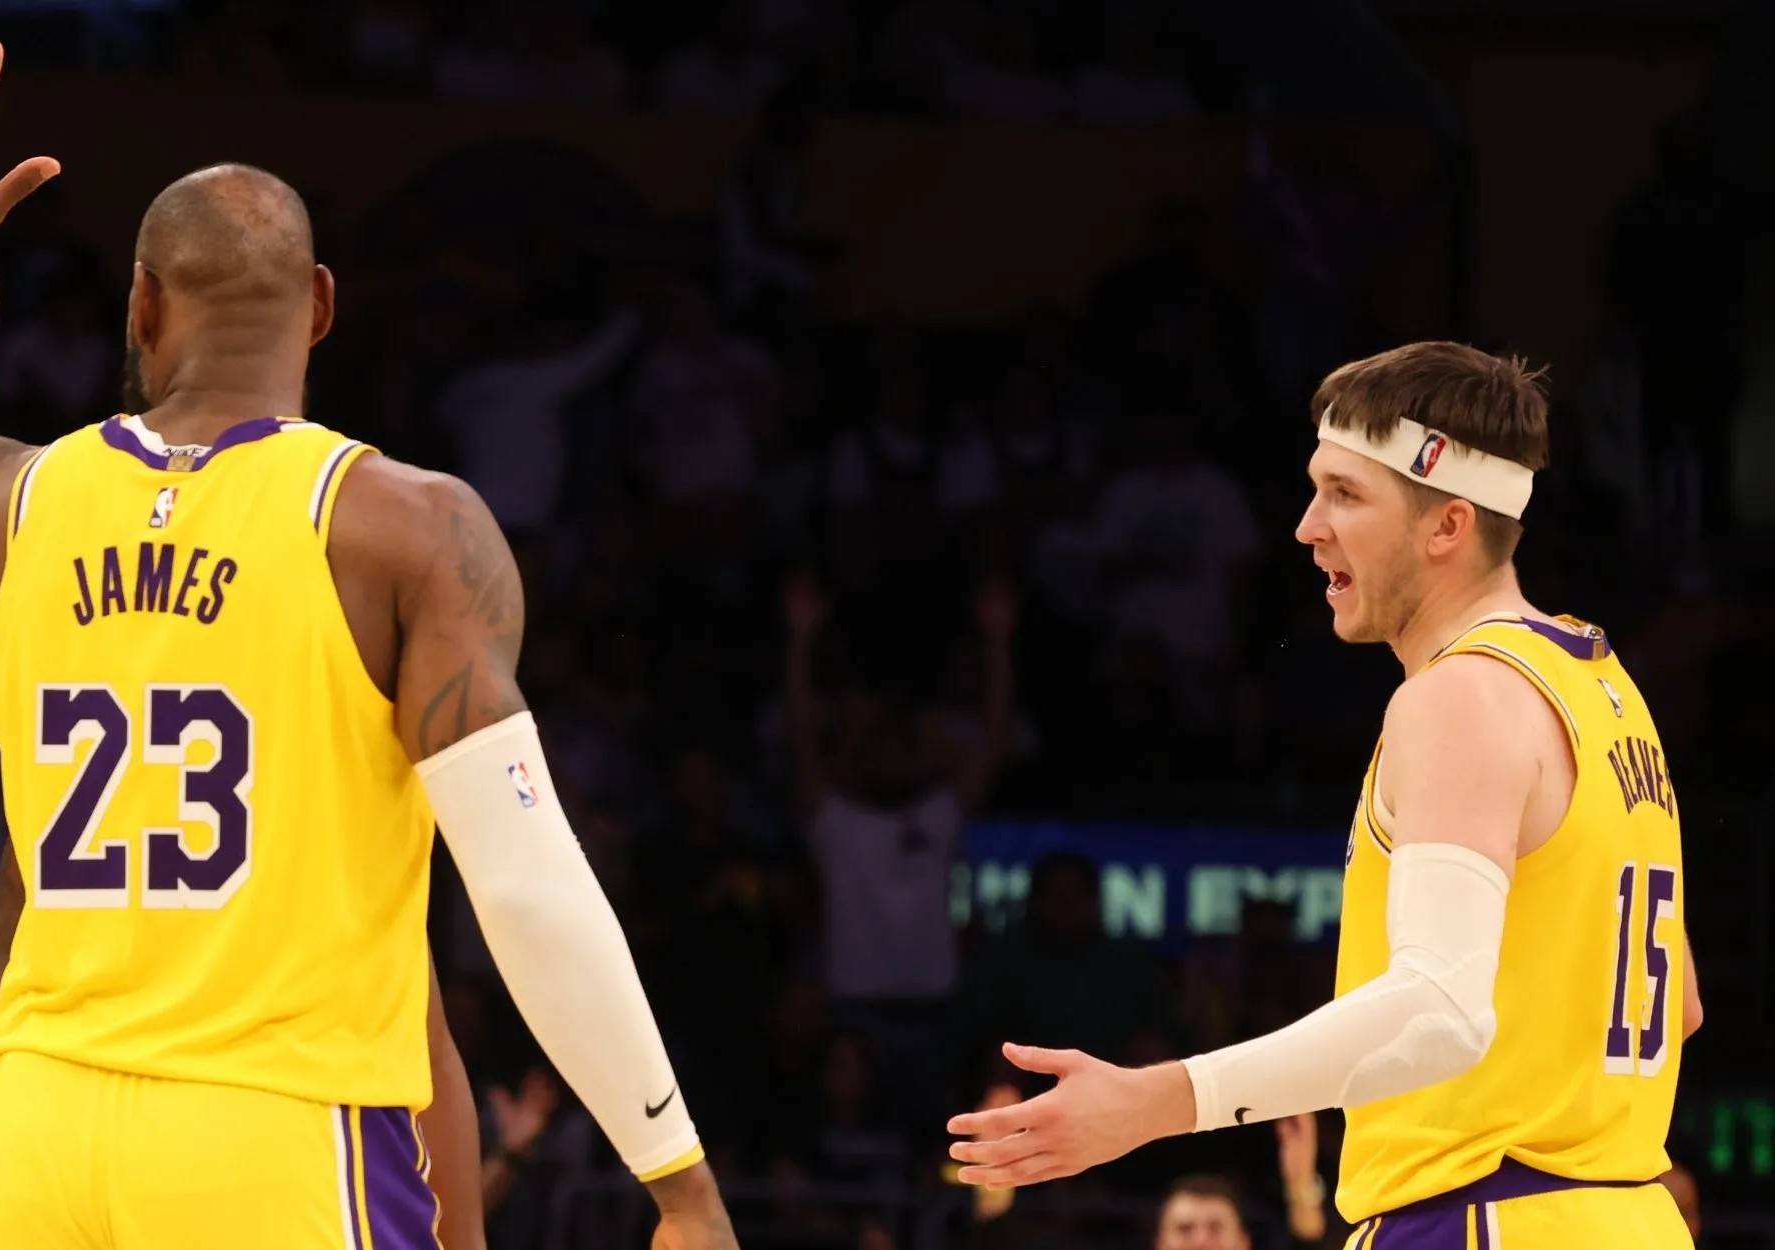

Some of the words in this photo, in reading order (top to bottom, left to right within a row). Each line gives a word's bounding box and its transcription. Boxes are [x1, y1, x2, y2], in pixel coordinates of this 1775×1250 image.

[72, 541, 238, 626] JAMES
[33, 681, 255, 911] 23
[1603, 860, 1677, 1078] 15
